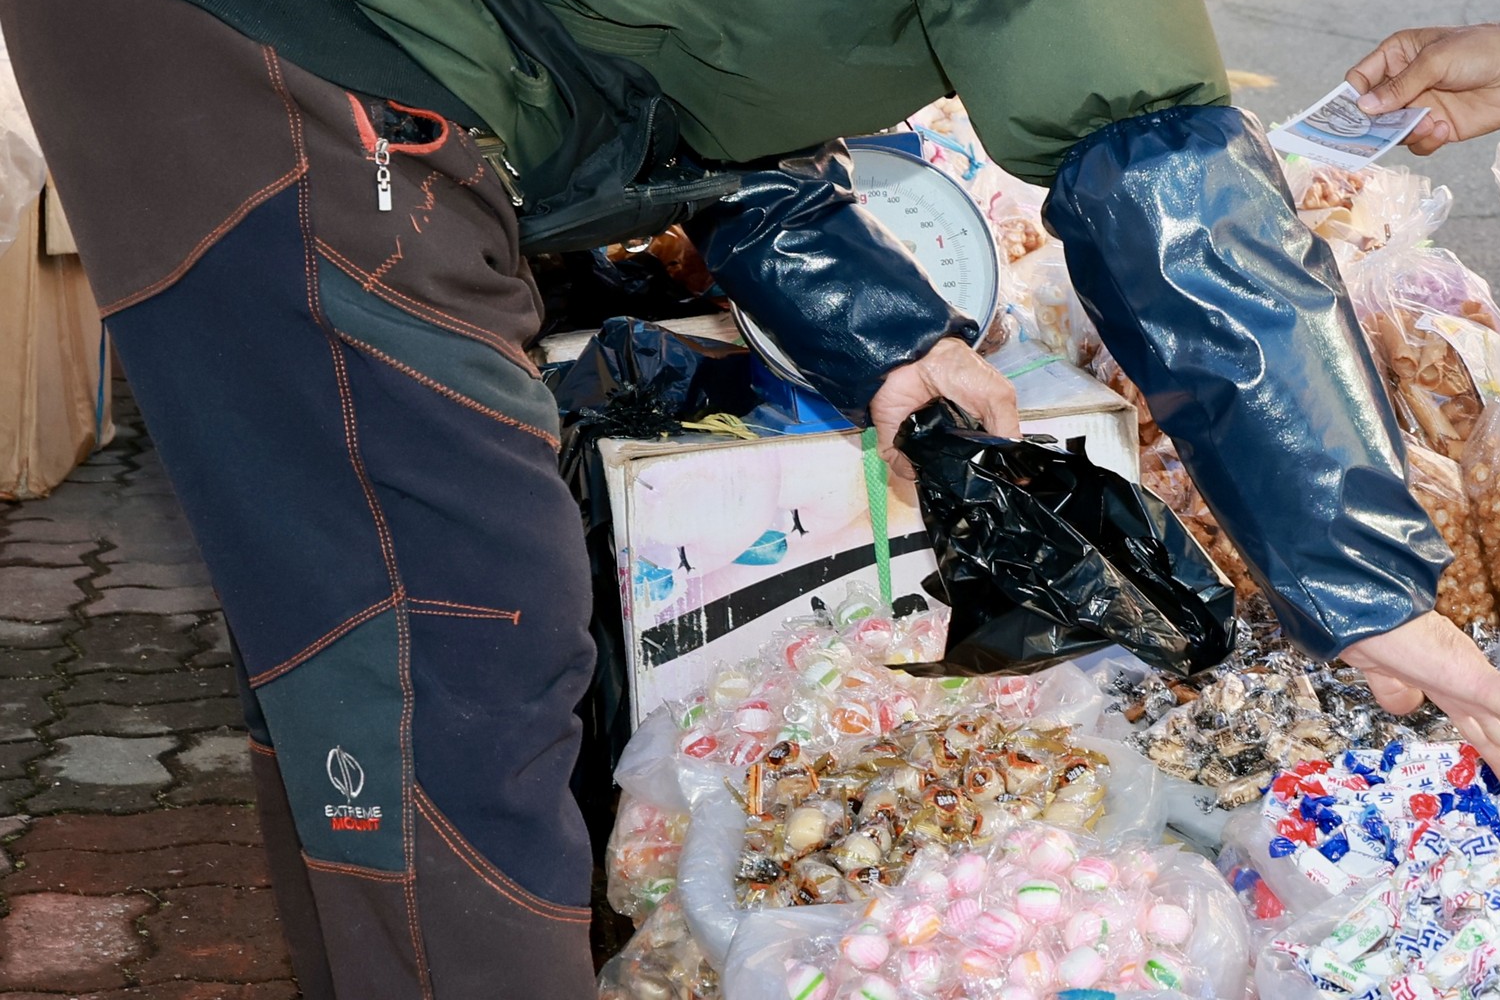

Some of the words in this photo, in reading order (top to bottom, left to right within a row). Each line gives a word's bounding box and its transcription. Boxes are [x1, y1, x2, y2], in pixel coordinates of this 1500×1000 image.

[868, 190, 880, 198] 200
[860, 194, 867, 205] g
[887, 196, 900, 204] 400
[904, 207, 919, 215] 600
[920, 221, 934, 229] 800
[936, 235, 944, 249] 1
[940, 258, 954, 266] 200
[943, 280, 956, 288] 400
[1400, 763, 1426, 777] Milk
[324, 804, 383, 819] EXTREME
[331, 816, 380, 831] MOUNT
